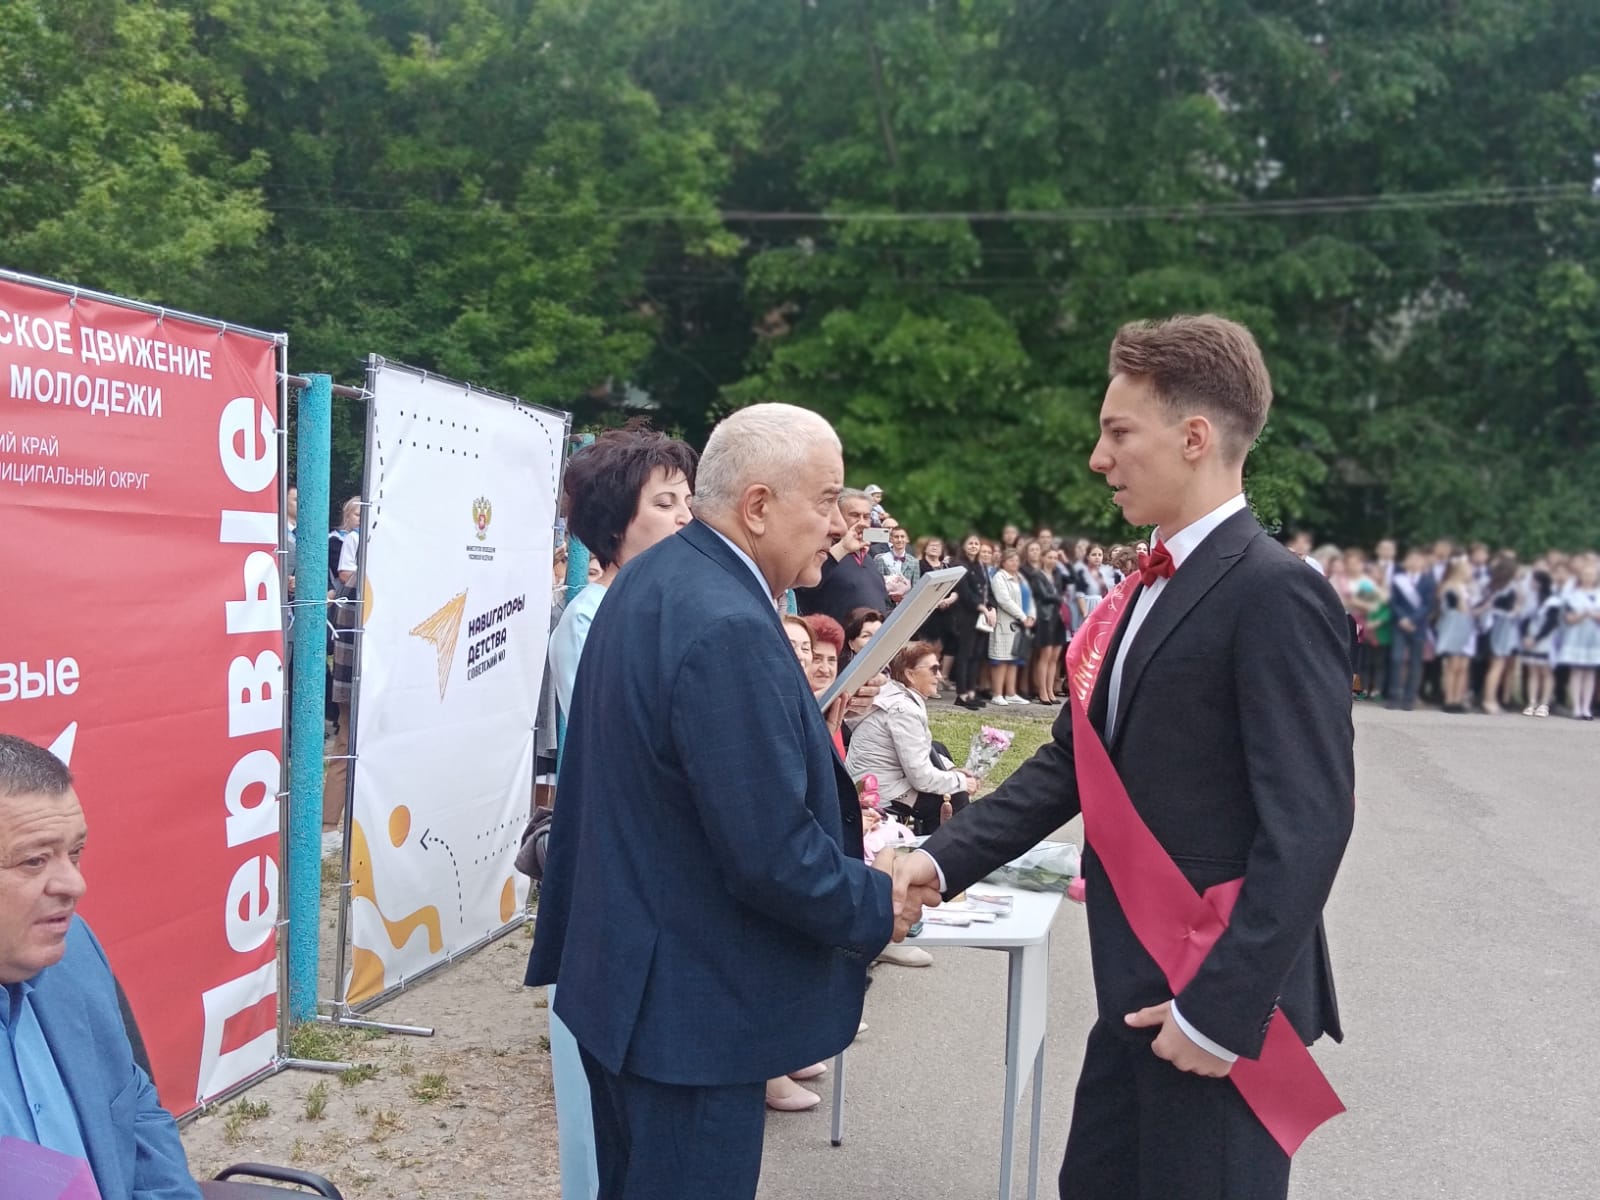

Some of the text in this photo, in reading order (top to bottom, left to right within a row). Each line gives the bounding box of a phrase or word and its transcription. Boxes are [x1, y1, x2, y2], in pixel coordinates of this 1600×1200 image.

[80, 326, 213, 380] ДВИЖЕНИЕ
[10, 364, 163, 417] МОЛОДЕЖИ
[21, 434, 59, 457] КРАЙ
[0, 461, 150, 489] ИЦИПАЛЬНЫЙ ОКРУГ
[468, 594, 526, 638] НАВИГАТОРЫ
[467, 627, 507, 667] ДЕТСТВА
[467, 653, 498, 681] СОВЕТСКИЙ
[196, 396, 279, 1104] Первые
